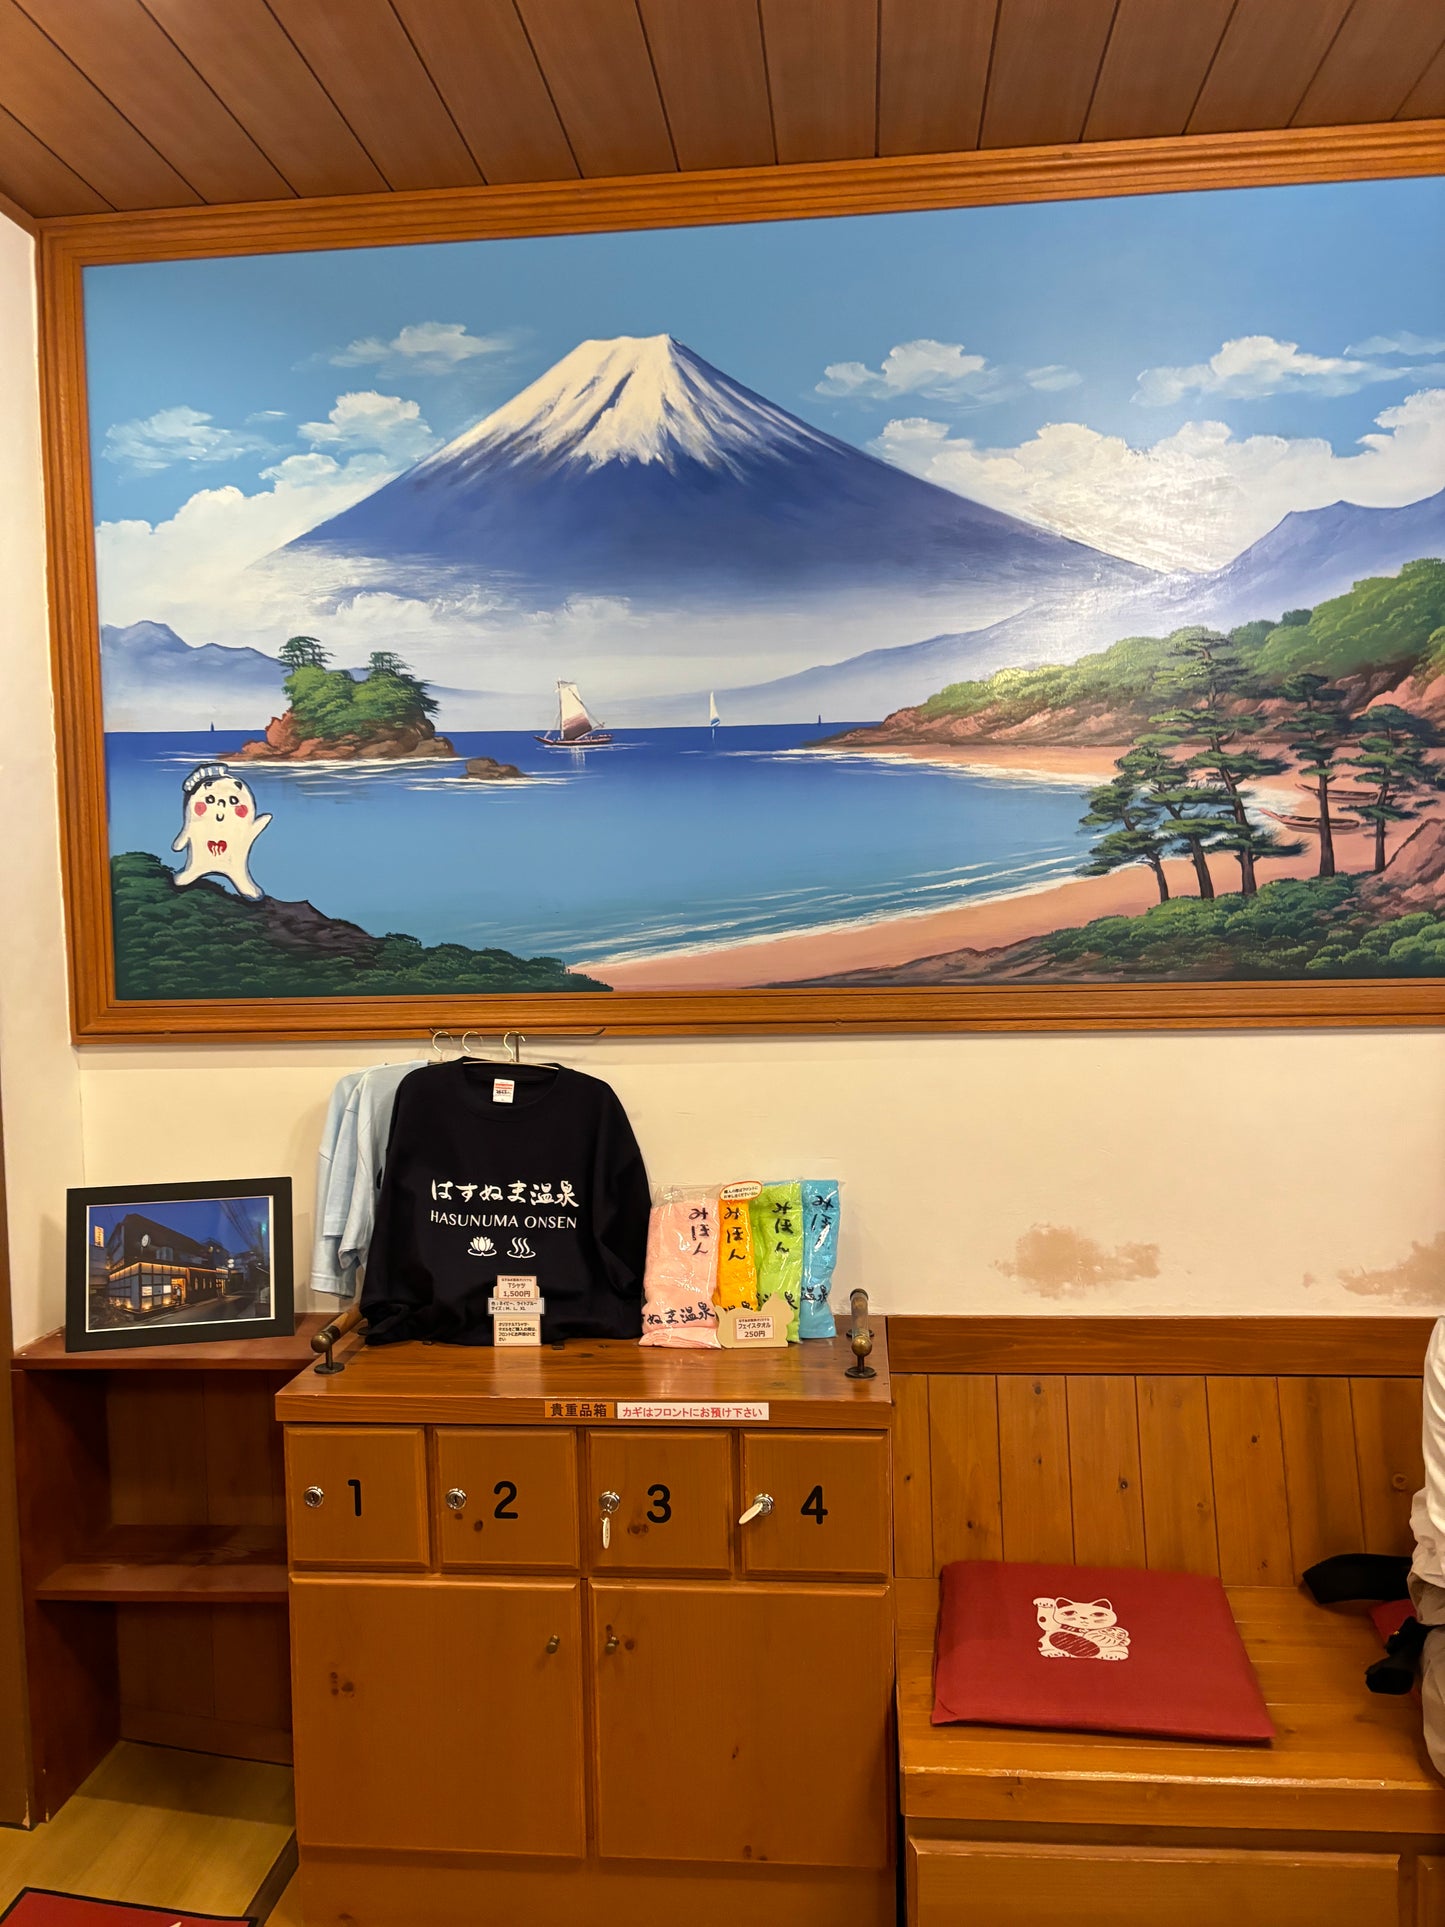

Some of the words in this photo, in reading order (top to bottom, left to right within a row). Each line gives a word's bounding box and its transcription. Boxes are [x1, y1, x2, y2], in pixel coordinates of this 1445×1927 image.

[431, 1178, 580, 1208] はすぬま温泉
[430, 1209, 519, 1228] HASUNUMA
[524, 1215, 577, 1229] ONSEN
[688, 1207, 710, 1256] みほん
[723, 1207, 746, 1261] みほん
[772, 1201, 794, 1254] みほん
[738, 1322, 771, 1330] フェイスタオル
[744, 1330, 766, 1338] 250円
[550, 1403, 608, 1418] 貴重品箱
[622, 1406, 763, 1418] カギはフロントにお預け下さい
[347, 1479, 362, 1517] 1
[493, 1480, 519, 1519] 2
[646, 1484, 672, 1524] 3
[800, 1485, 829, 1525] 4
